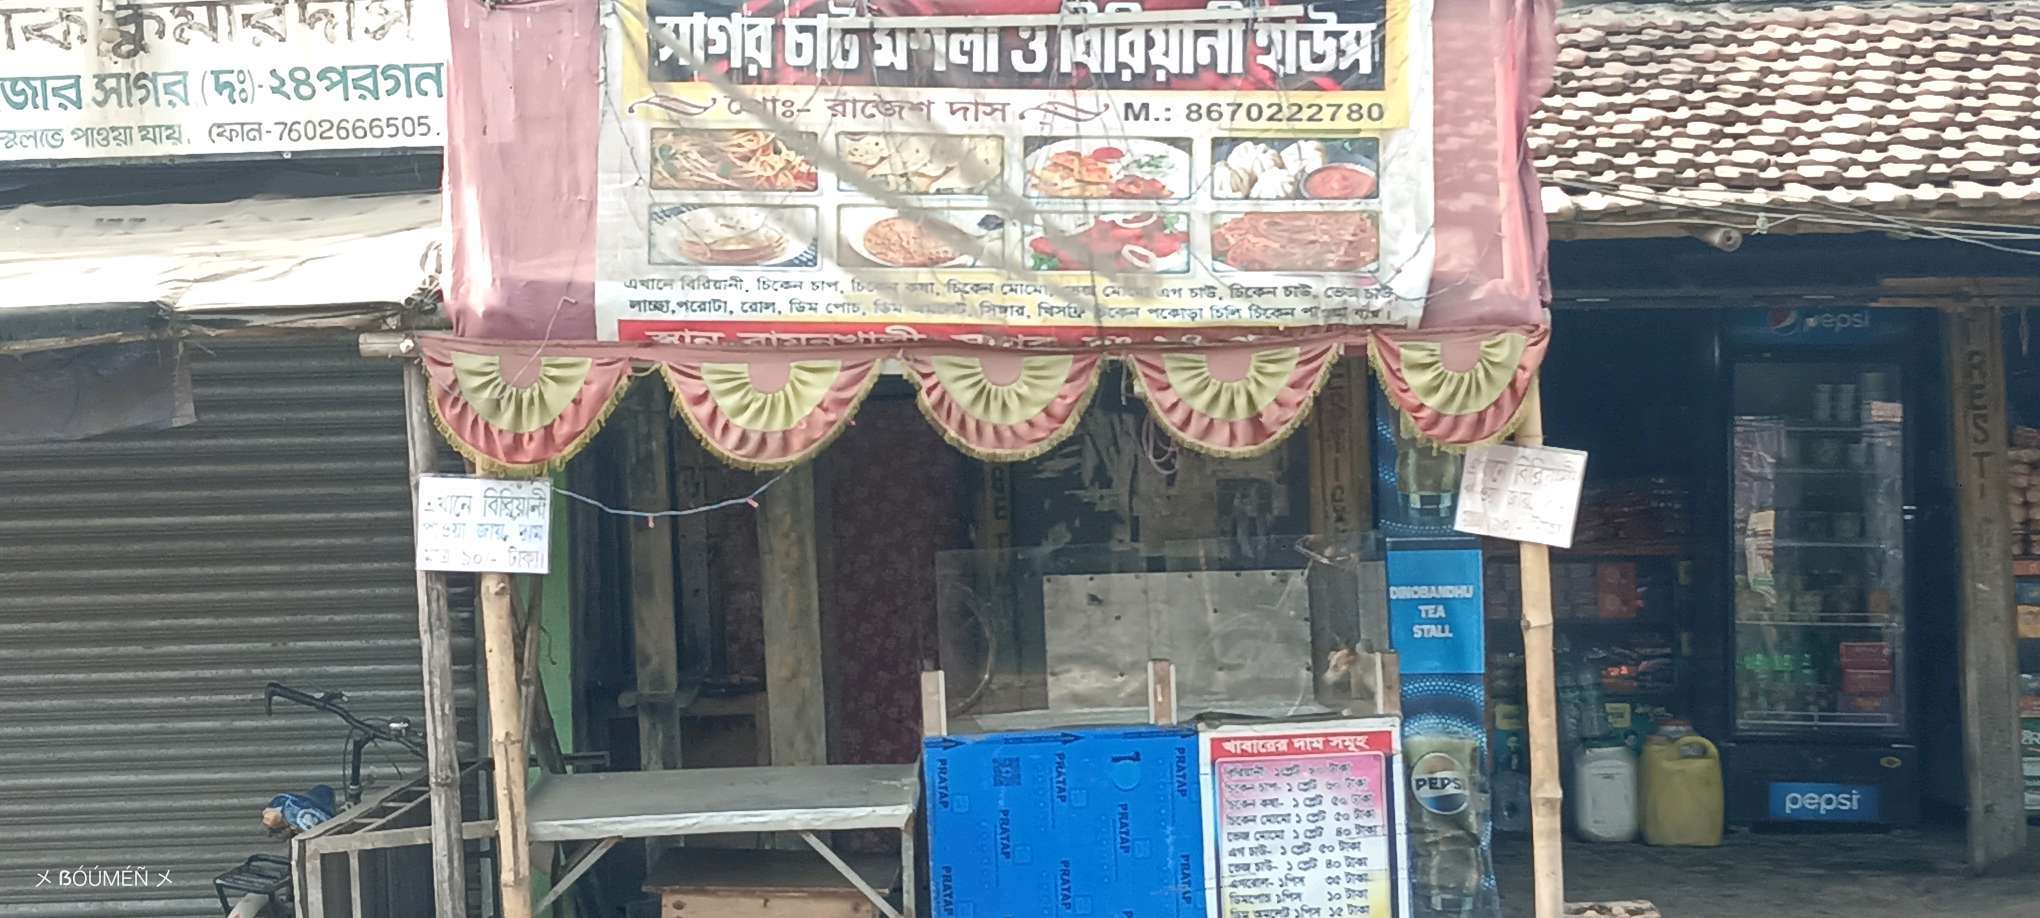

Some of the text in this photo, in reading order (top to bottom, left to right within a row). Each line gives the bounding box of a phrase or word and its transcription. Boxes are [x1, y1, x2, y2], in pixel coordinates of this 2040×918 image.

[655, 12, 775, 77] সাগর
[1010, 27, 1049, 73] ও
[91, 70, 190, 109] সাগর
[824, 97, 934, 121] রাজেশ
[946, 98, 1009, 123] দাস
[1185, 102, 1384, 123] 8670222780
[71, 124, 134, 149] পাওয়া
[789, 298, 818, 314] ডিম
[1248, 304, 1296, 320] চিকেন
[1412, 624, 1453, 638] STALL
[1417, 604, 1446, 619] TEA
[1292, 736, 1325, 752] দাম
[936, 758, 949, 809] PRATAP
[1055, 752, 1066, 804] PRATAP
[1175, 747, 1187, 798] PRATAP
[1785, 790, 1861, 815] pepsi
[999, 809, 1011, 860] PRATAP
[1118, 803, 1130, 855] PRATAP
[942, 866, 955, 917] PRATAP
[1060, 860, 1073, 911] PRATAP
